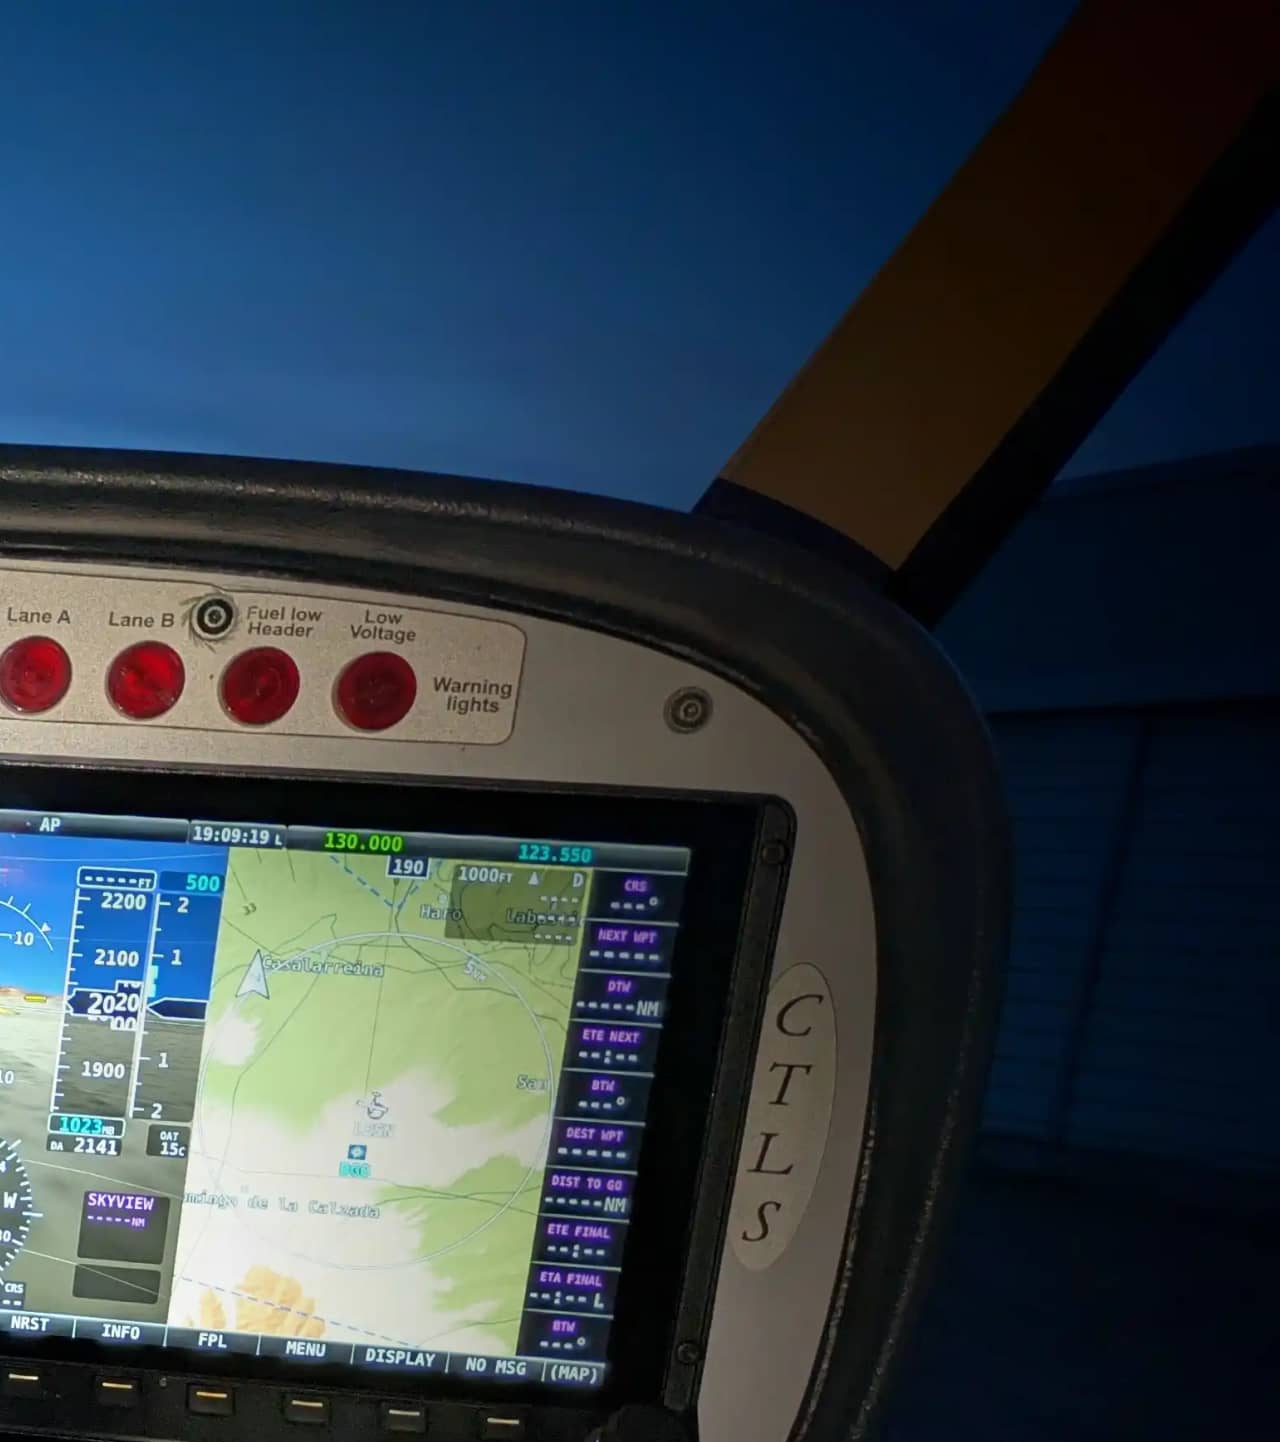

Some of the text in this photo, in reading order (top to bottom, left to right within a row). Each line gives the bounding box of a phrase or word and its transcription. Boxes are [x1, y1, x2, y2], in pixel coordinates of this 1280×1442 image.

[8, 607, 71, 624] Lane A
[109, 612, 174, 627] Lane B
[247, 606, 322, 622] Fuel low
[365, 610, 403, 624] Low
[248, 622, 314, 638] Header
[350, 624, 416, 644] Voltage
[433, 677, 512, 699] Warning
[447, 696, 499, 714] lights
[325, 832, 592, 863] 130.000 123.550
[420, 905, 462, 922] Haro
[95, 950, 139, 966] 2100
[88, 1193, 153, 1211] SKYVIEW
[11, 1315, 49, 1331] NRST
[102, 1324, 140, 1339] INFO
[198, 1333, 598, 1383] FPL MENU DISPLAY NO MSG (MAP)
